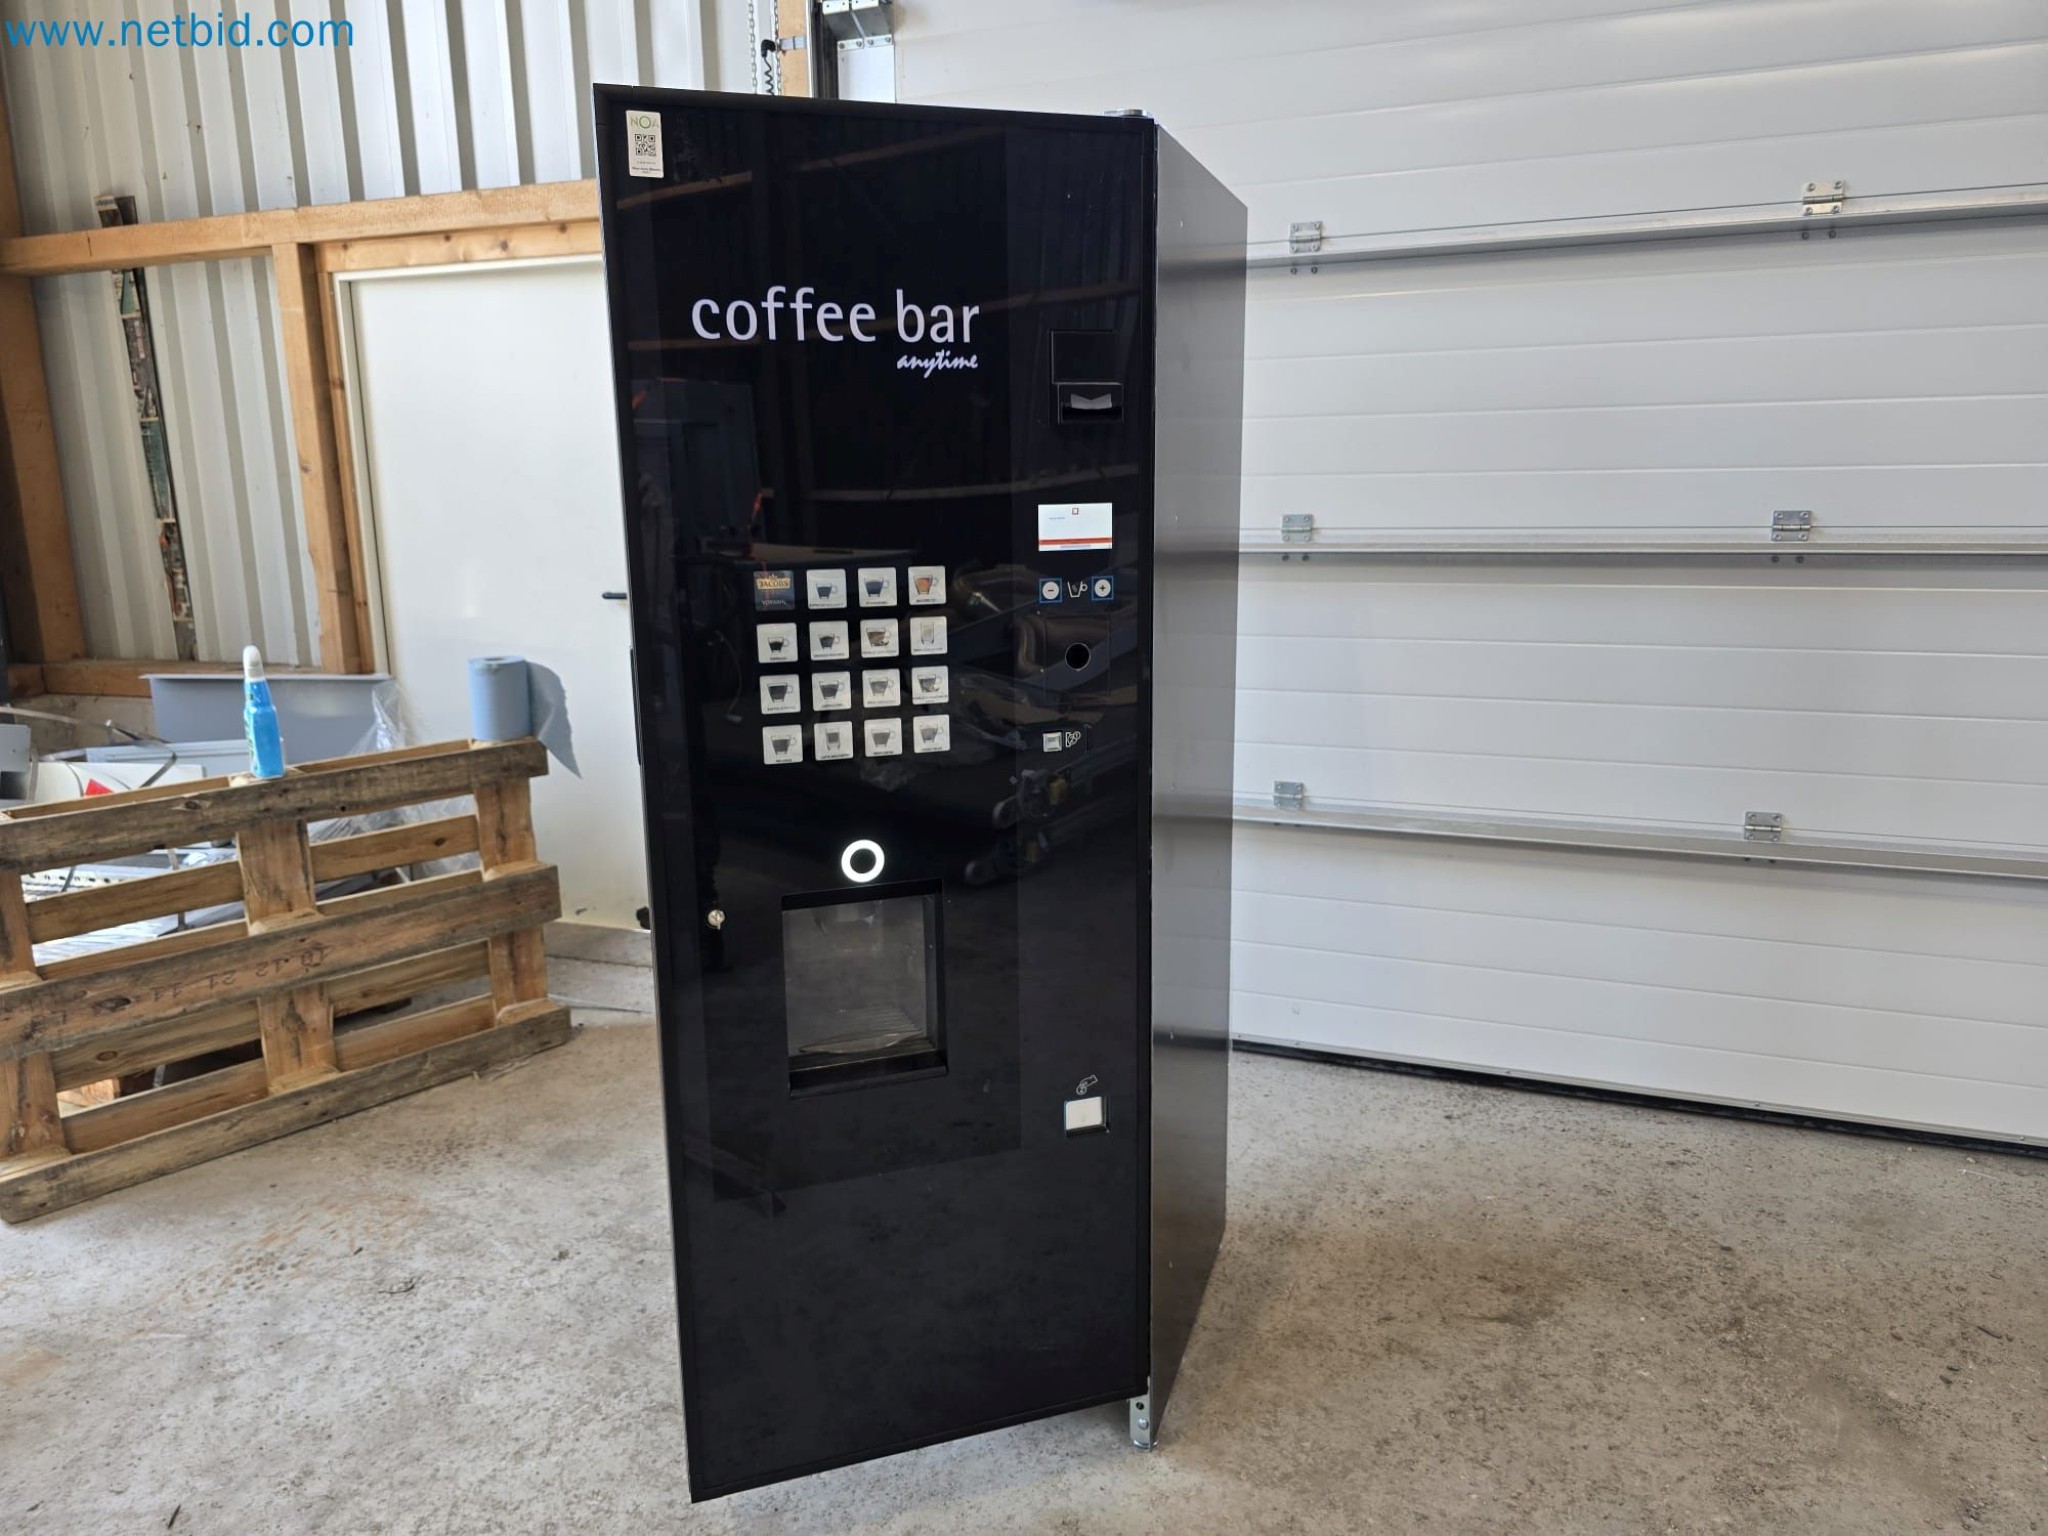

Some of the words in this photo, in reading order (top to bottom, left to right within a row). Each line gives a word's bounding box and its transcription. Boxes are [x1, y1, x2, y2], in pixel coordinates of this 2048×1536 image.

[691, 285, 877, 343] coffee
[896, 288, 980, 344] bar
[896, 349, 979, 379] anytime
[759, 580, 789, 588] JACOBS
